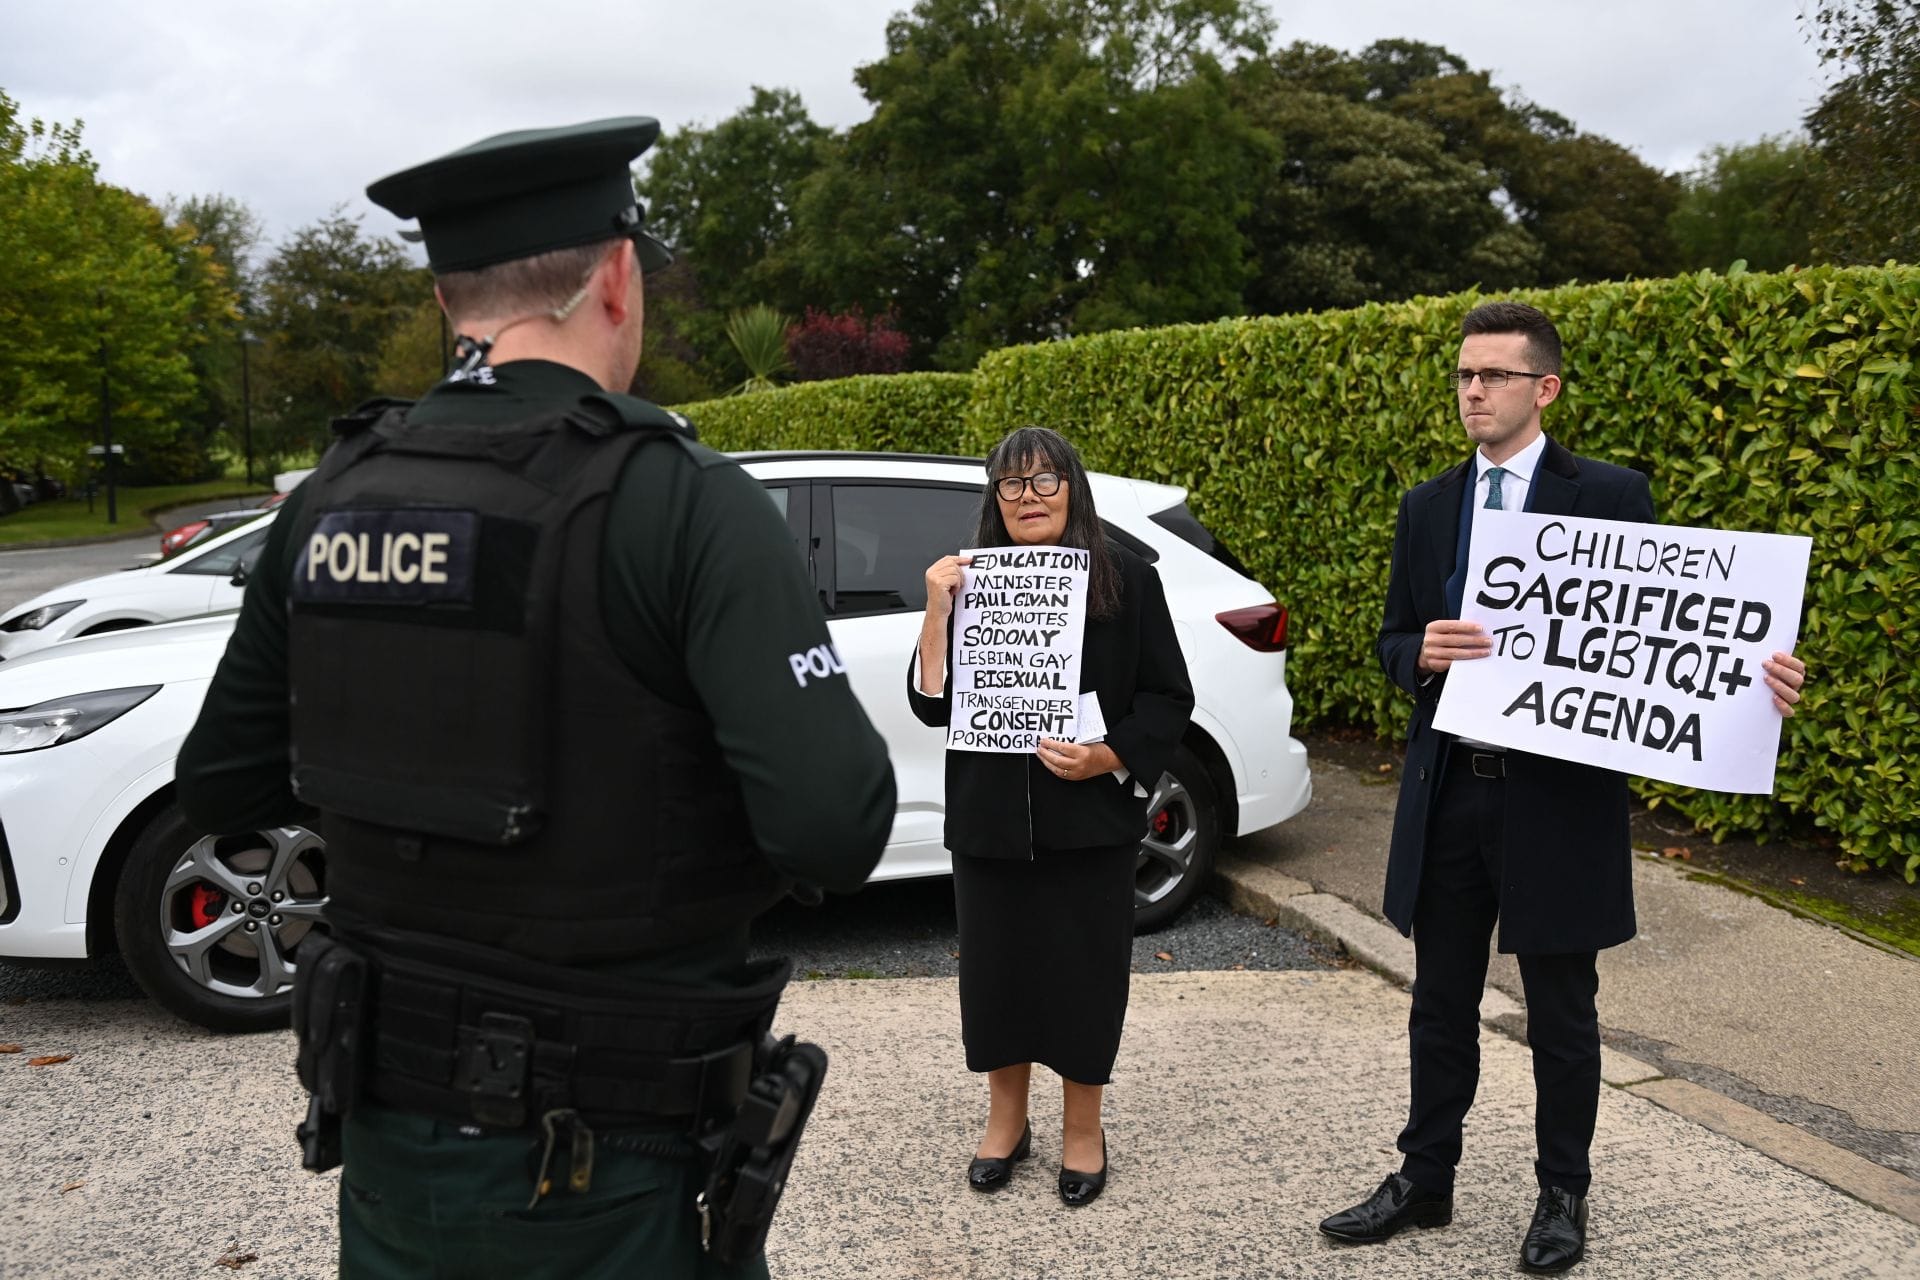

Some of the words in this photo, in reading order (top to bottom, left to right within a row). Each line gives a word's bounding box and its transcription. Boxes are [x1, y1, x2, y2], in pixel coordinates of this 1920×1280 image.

[307, 532, 450, 583] POLICE
[969, 551, 1088, 571] EDUCATION
[1536, 521, 1736, 581] CHILDREN
[973, 574, 1072, 591] MINISTER
[964, 592, 1011, 609] PAUL
[1013, 592, 1069, 608] GIVAN
[1475, 556, 1772, 643] SACRIFICED
[981, 611, 1069, 627] PROMOTES
[963, 625, 1060, 647] SODOMY
[788, 643, 847, 688] POL
[1029, 652, 1073, 670] GAY
[1493, 623, 1535, 660] TO
[1543, 619, 1752, 701] LGBTQI+
[974, 670, 1067, 690] BISEXUAL
[957, 691, 1073, 713] TRANSGENDER
[970, 709, 1074, 734] CONSENT
[1502, 681, 1703, 762] AGENDA
[952, 730, 1077, 749] PORNOGRA
